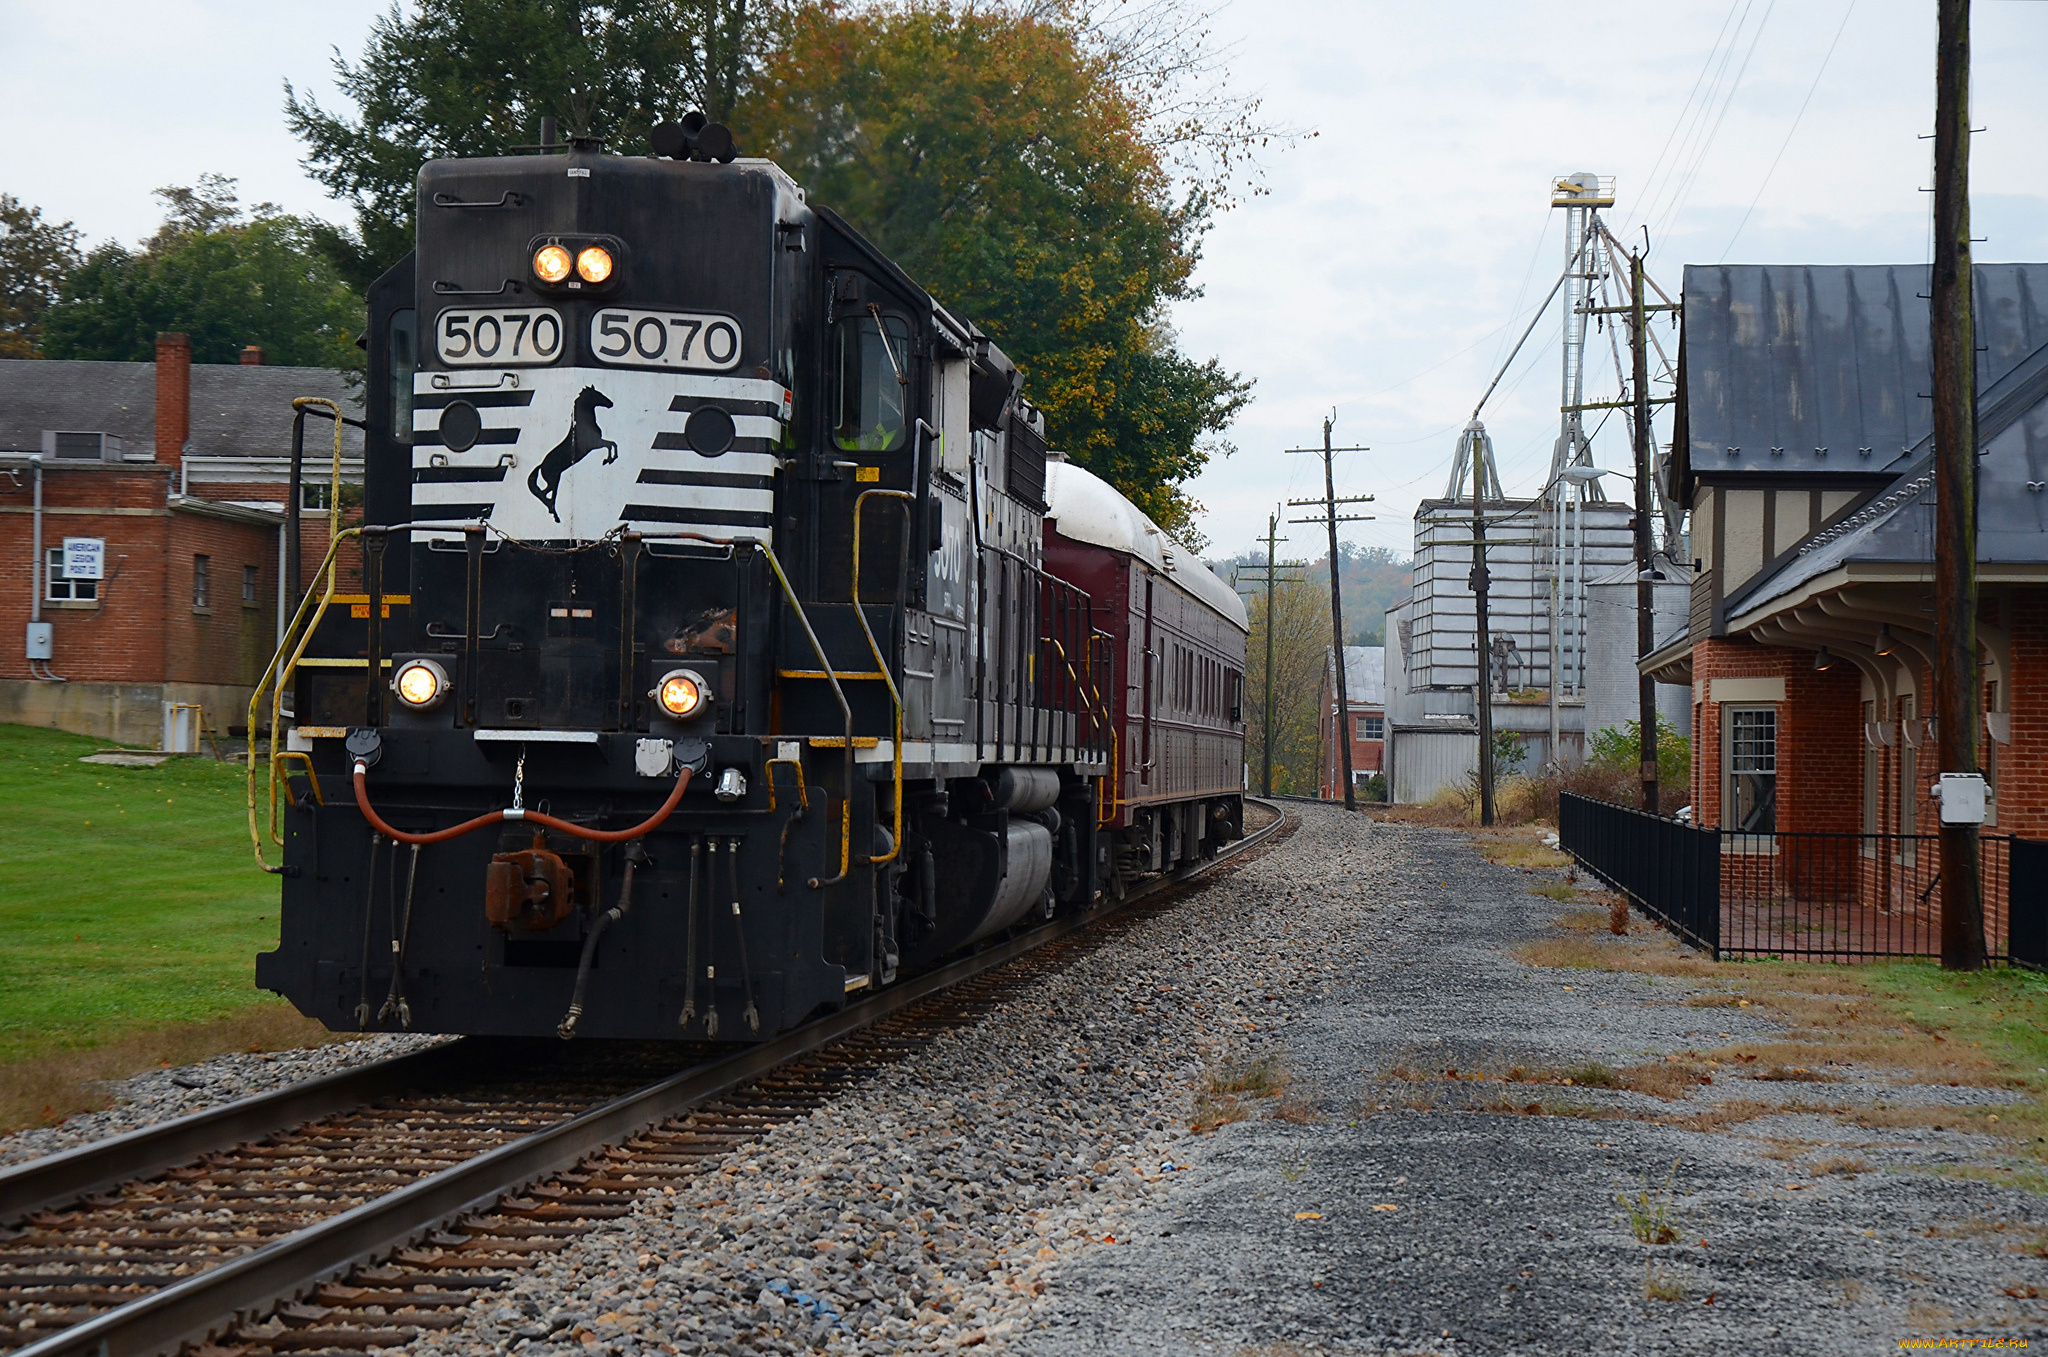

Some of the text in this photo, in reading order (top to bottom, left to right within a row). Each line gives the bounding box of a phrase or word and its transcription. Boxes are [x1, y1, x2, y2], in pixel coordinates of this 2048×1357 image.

[445, 314, 559, 358] 5070
[599, 314, 737, 364] 5070
[67, 542, 101, 552] AMERICAN
[71, 553, 95, 563] LEGION
[69, 565, 86, 575] POST
